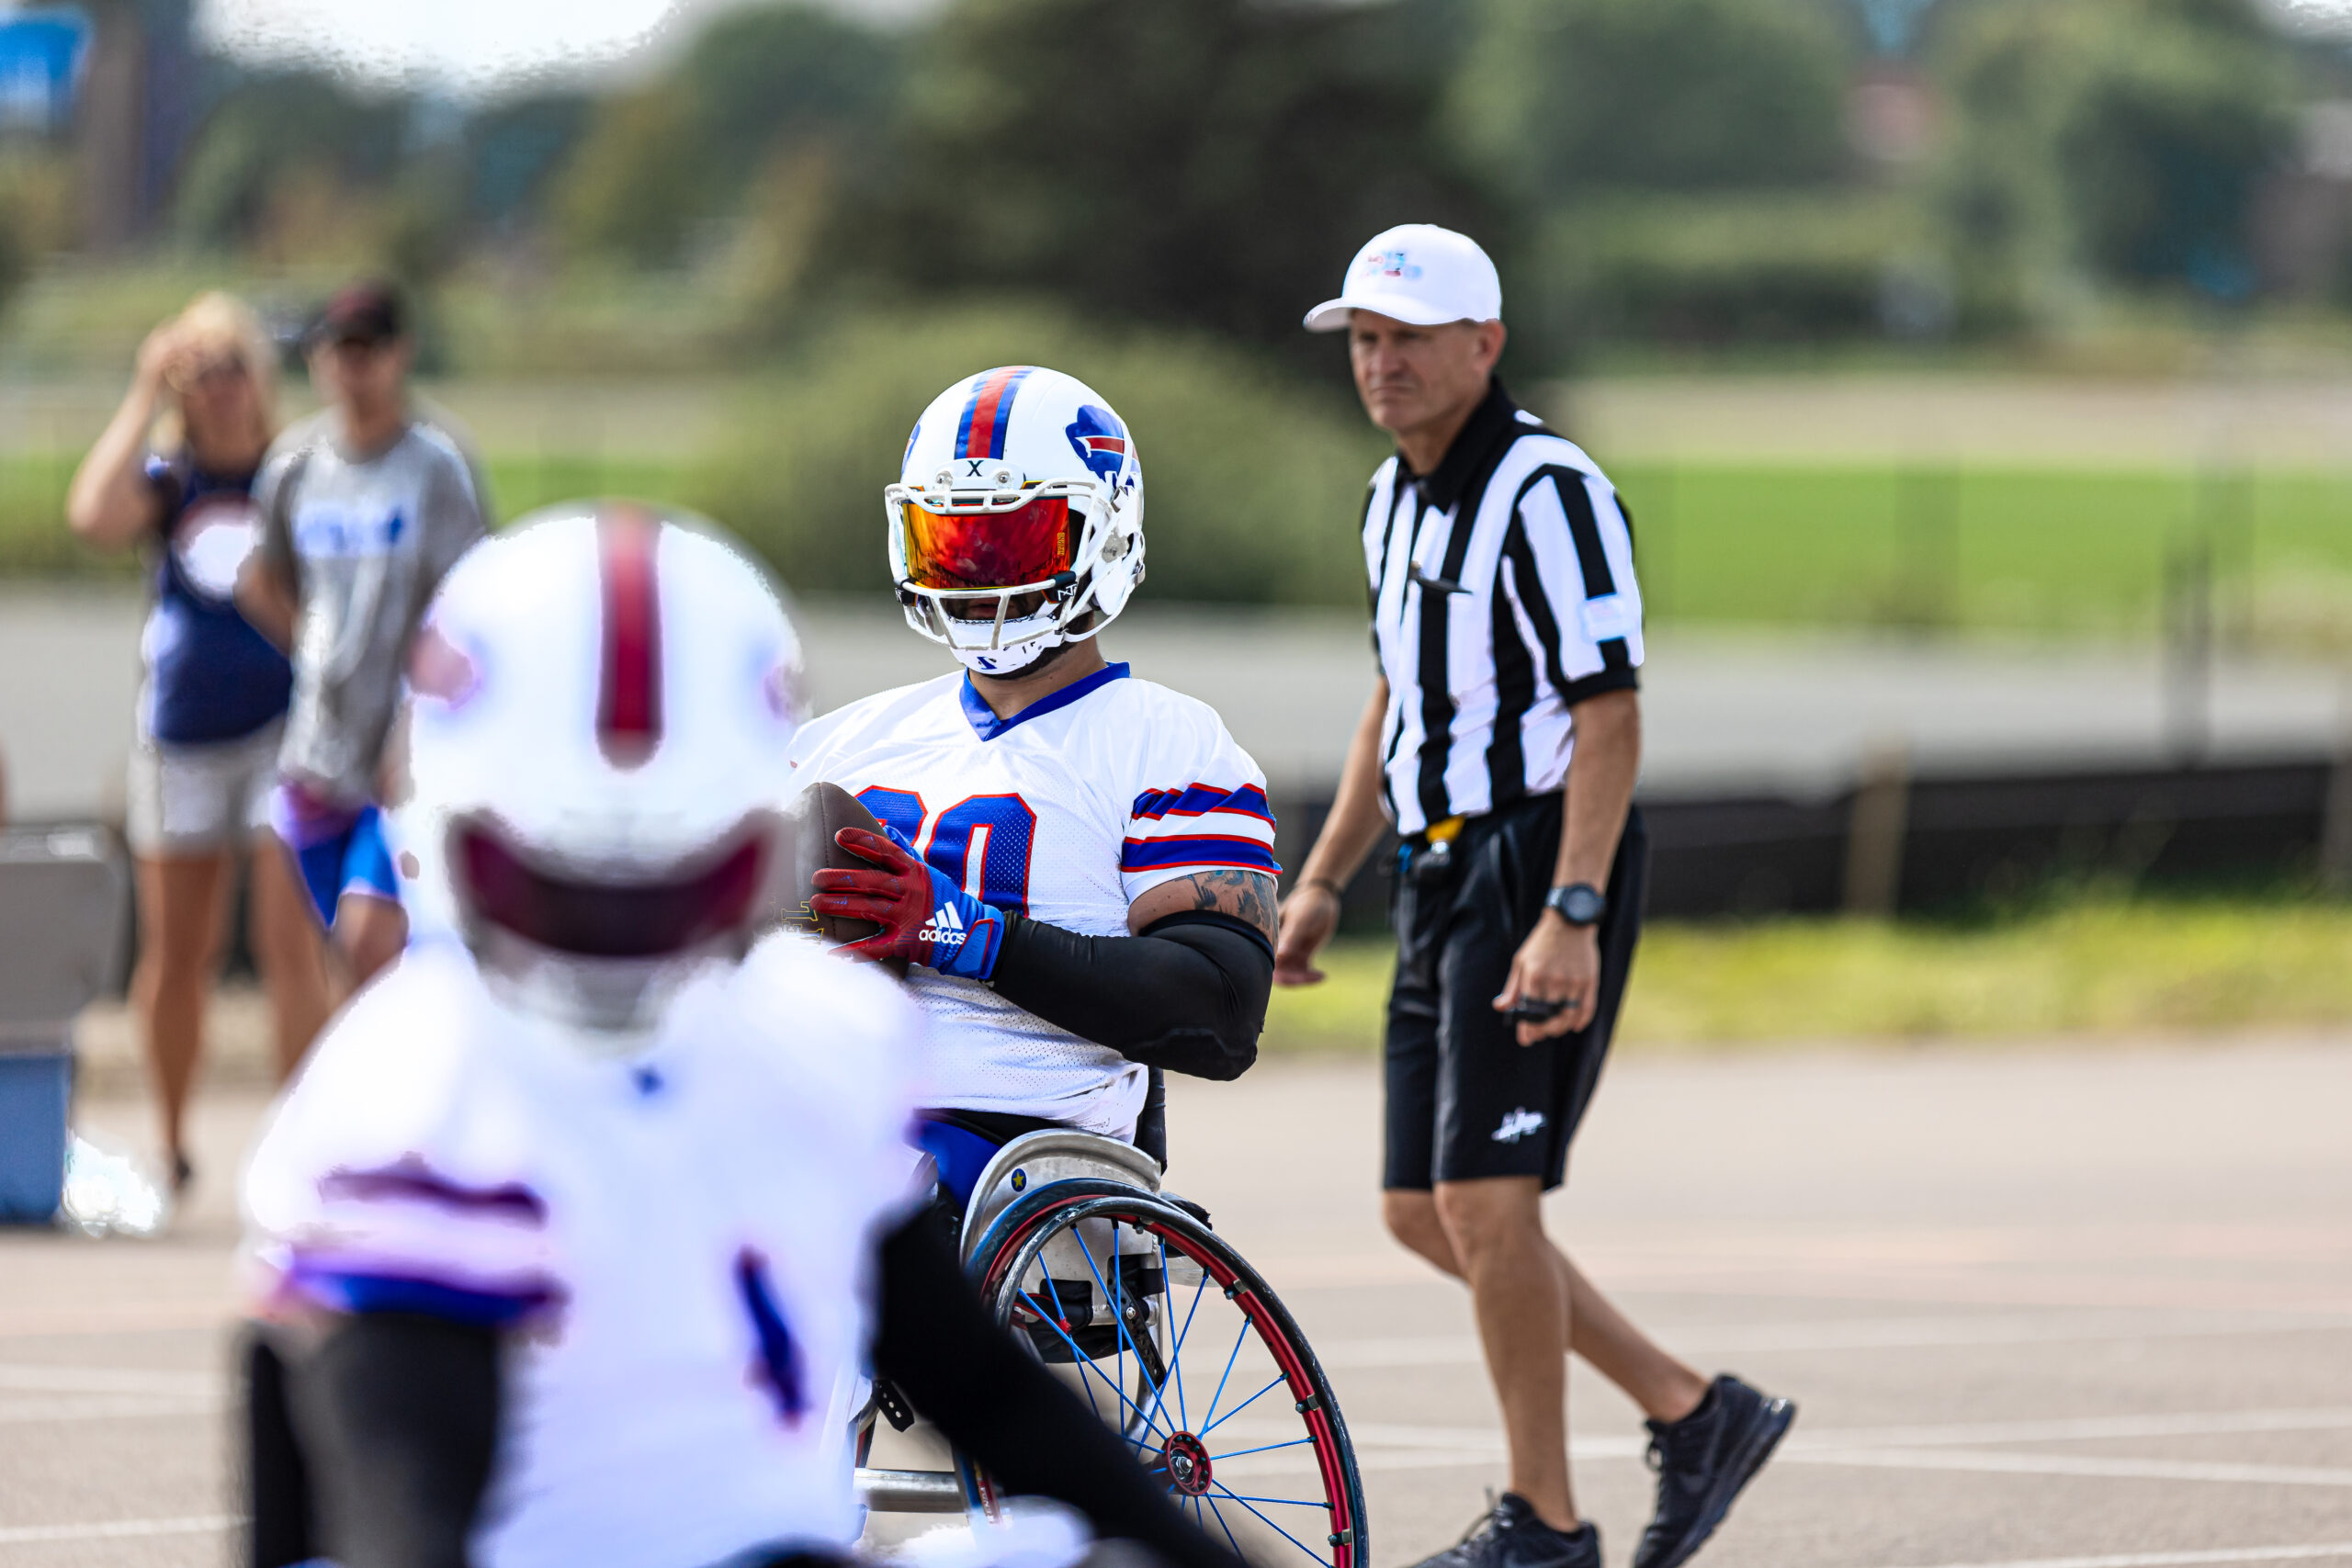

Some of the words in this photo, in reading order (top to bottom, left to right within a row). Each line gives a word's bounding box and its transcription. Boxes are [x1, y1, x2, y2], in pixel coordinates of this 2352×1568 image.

[966, 459, 984, 478] X
[781, 900, 824, 944] FL
[919, 927, 967, 945] adidas
